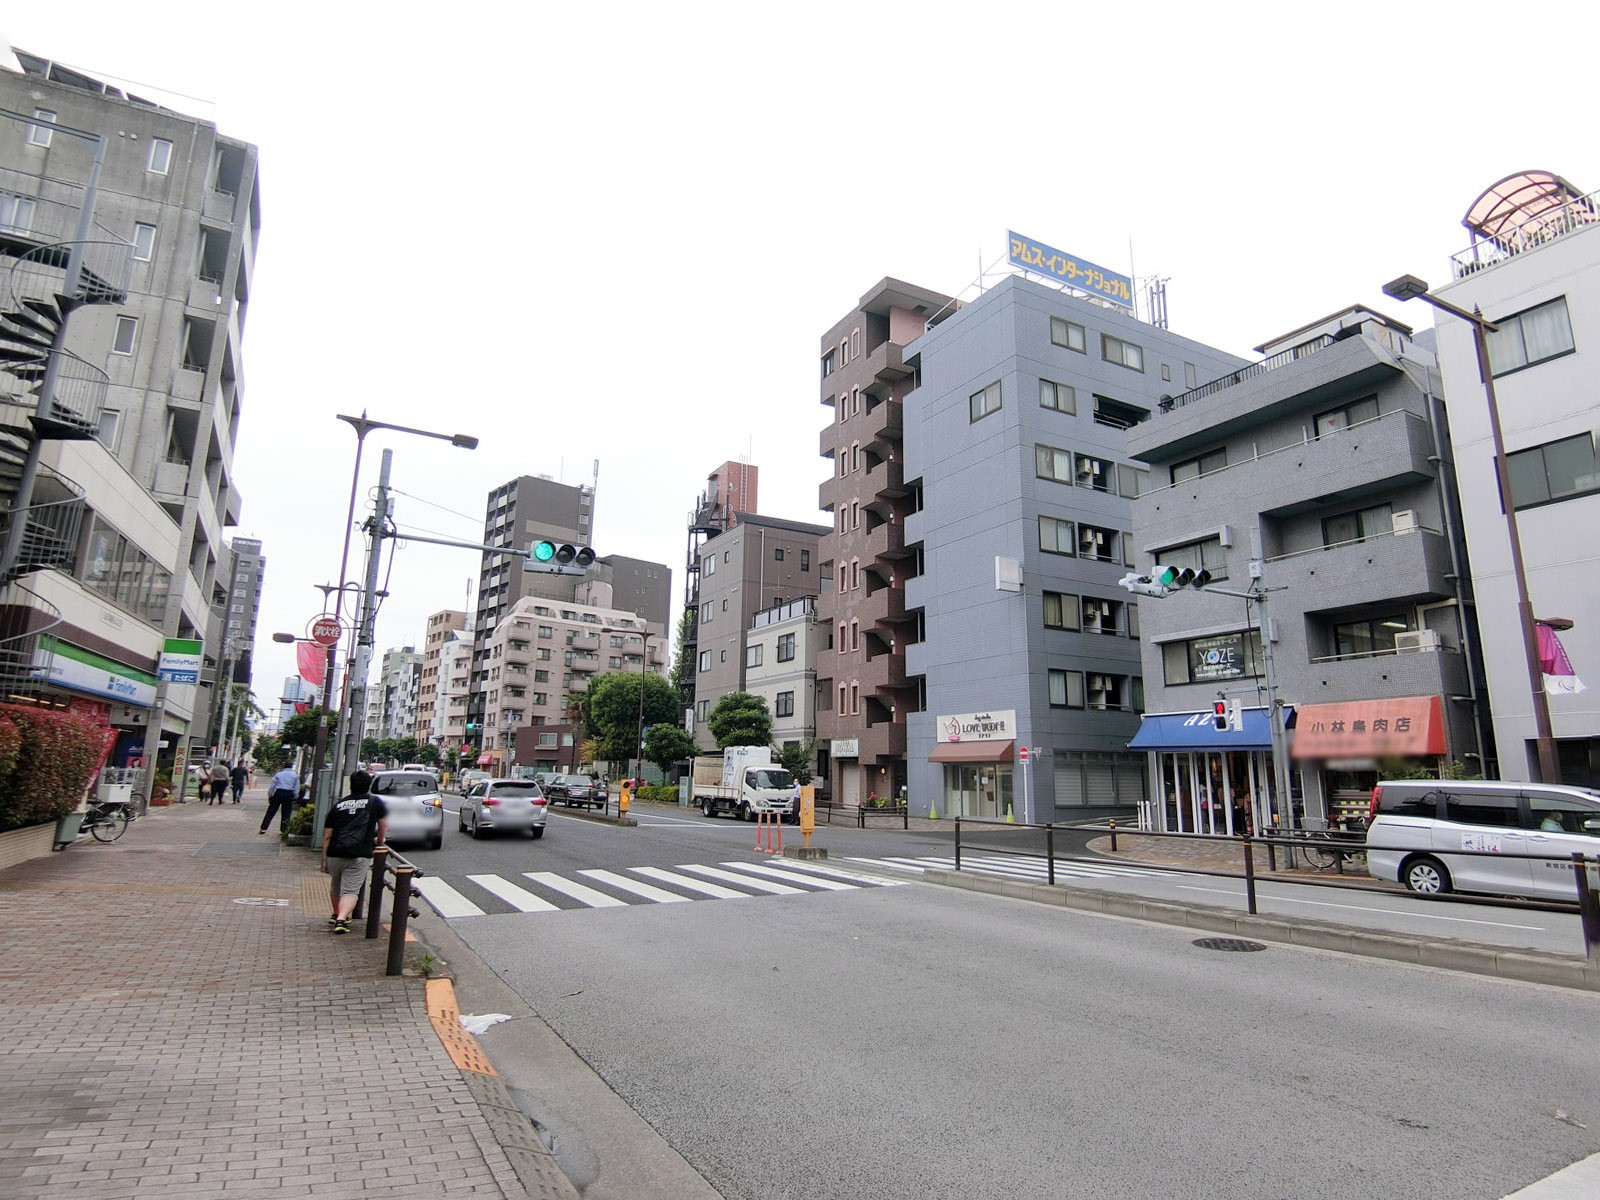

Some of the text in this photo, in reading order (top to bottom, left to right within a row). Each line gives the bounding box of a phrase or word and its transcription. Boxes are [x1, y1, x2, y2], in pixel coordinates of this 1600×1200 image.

[1011, 238, 1130, 300] アムス・インターナショナル
[314, 625, 340, 638] 消火栓
[162, 656, 200, 667] FamilyMart
[1199, 647, 1235, 665] YOZE
[161, 672, 195, 683] 酒 たばこ
[115, 678, 138, 696] FamilyMart
[1311, 717, 1411, 732] 小林鳥肉店
